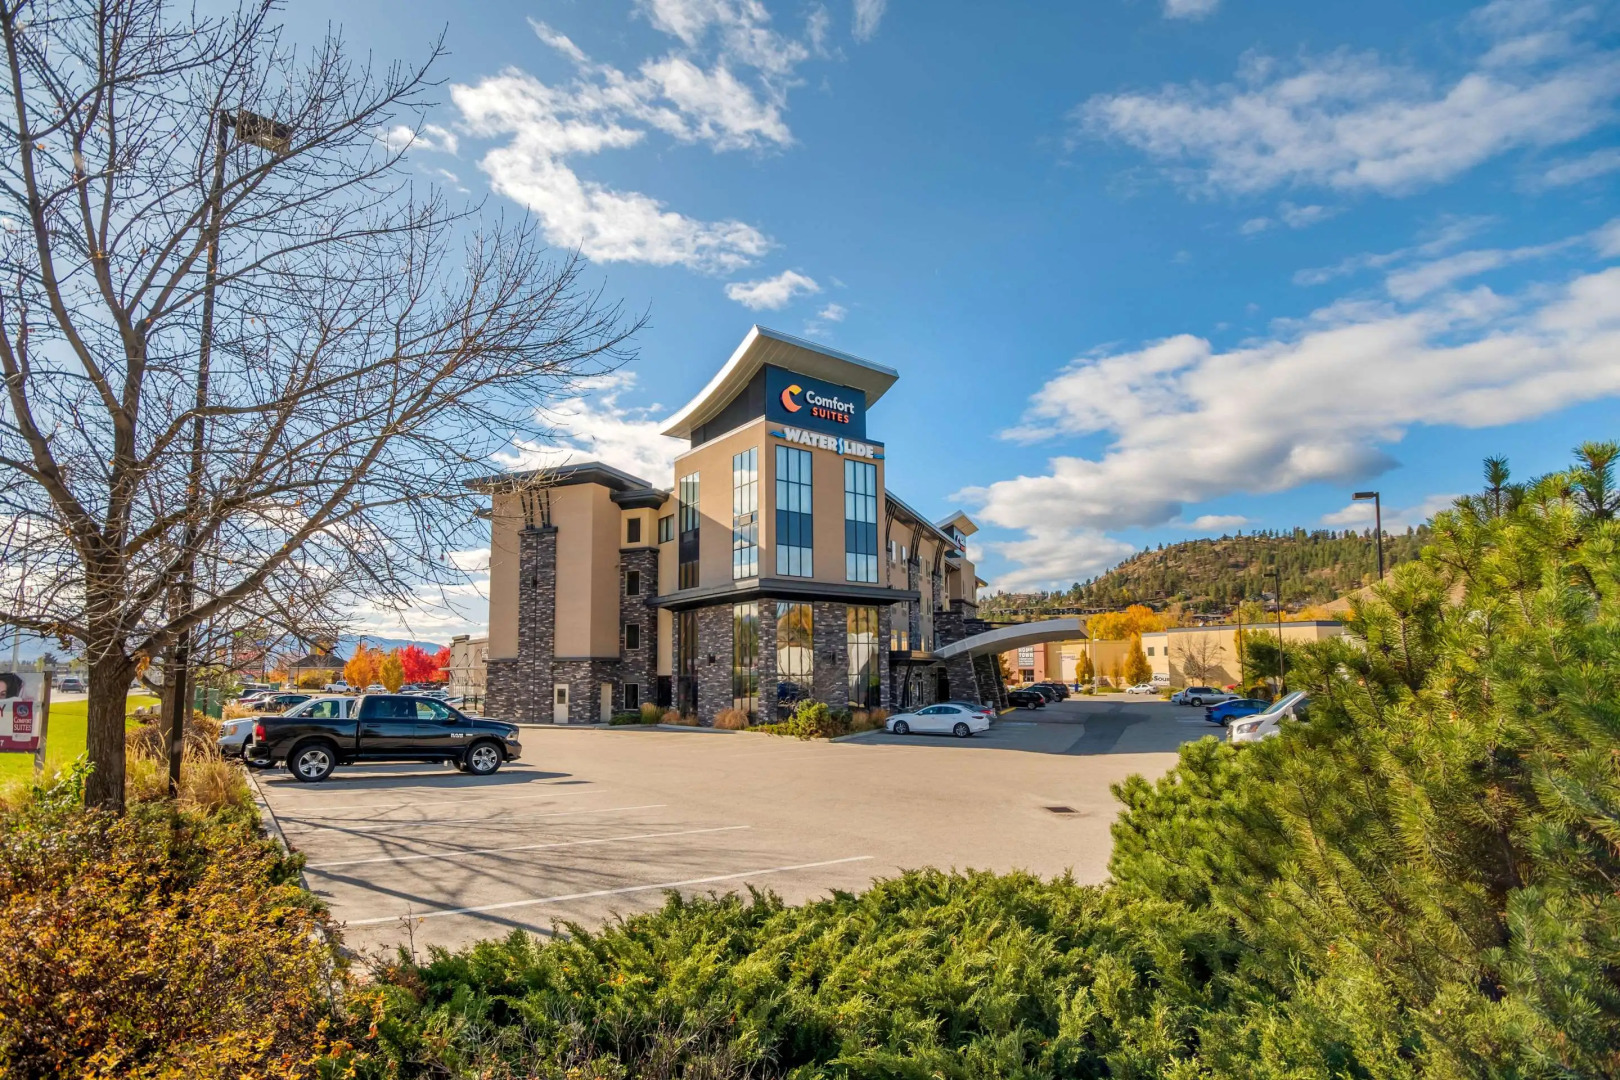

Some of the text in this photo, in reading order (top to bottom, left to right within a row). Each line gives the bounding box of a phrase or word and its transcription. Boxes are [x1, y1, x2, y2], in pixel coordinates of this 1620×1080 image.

[806, 391, 855, 414] Comfort
[811, 406, 850, 424] SUITES
[783, 427, 874, 459] WATERSLIDE
